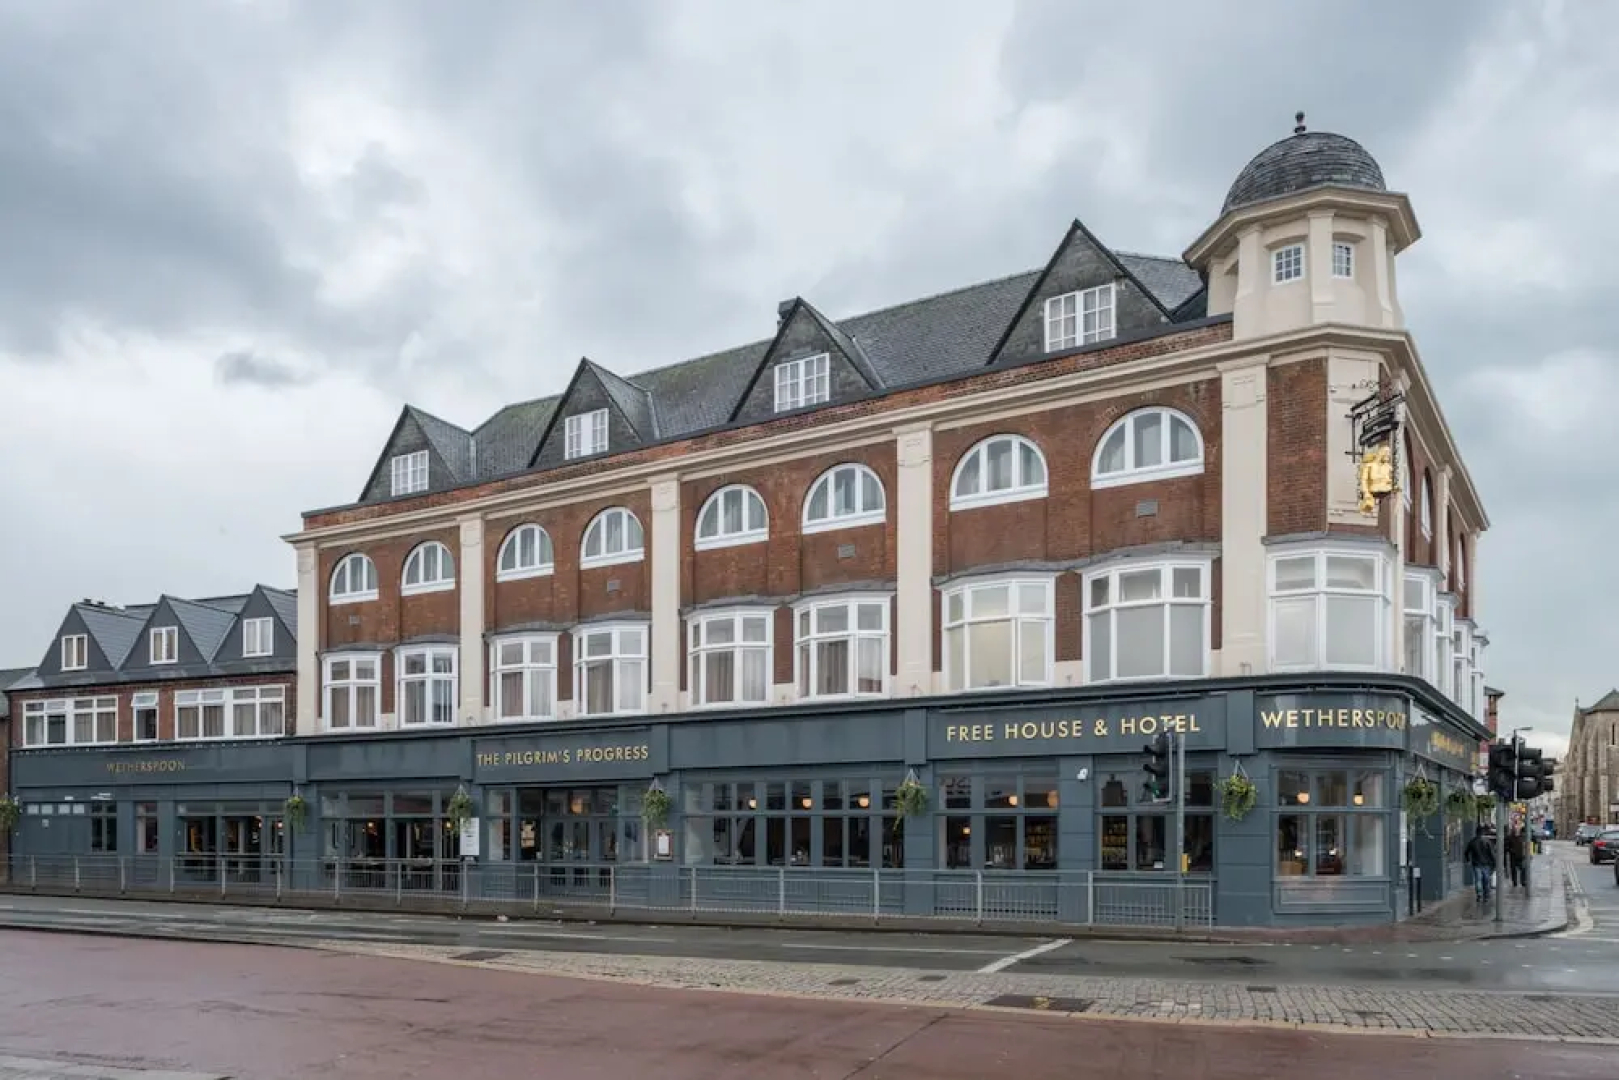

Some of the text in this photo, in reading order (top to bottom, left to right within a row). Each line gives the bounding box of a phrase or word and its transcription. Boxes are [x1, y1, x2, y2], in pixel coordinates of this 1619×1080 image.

[946, 714, 1201, 742] FREE HOUSE & HOTEL
[106, 759, 186, 774] WETHERSPOON
[476, 745, 649, 767] THE PILGRIM'S PROGRESS
